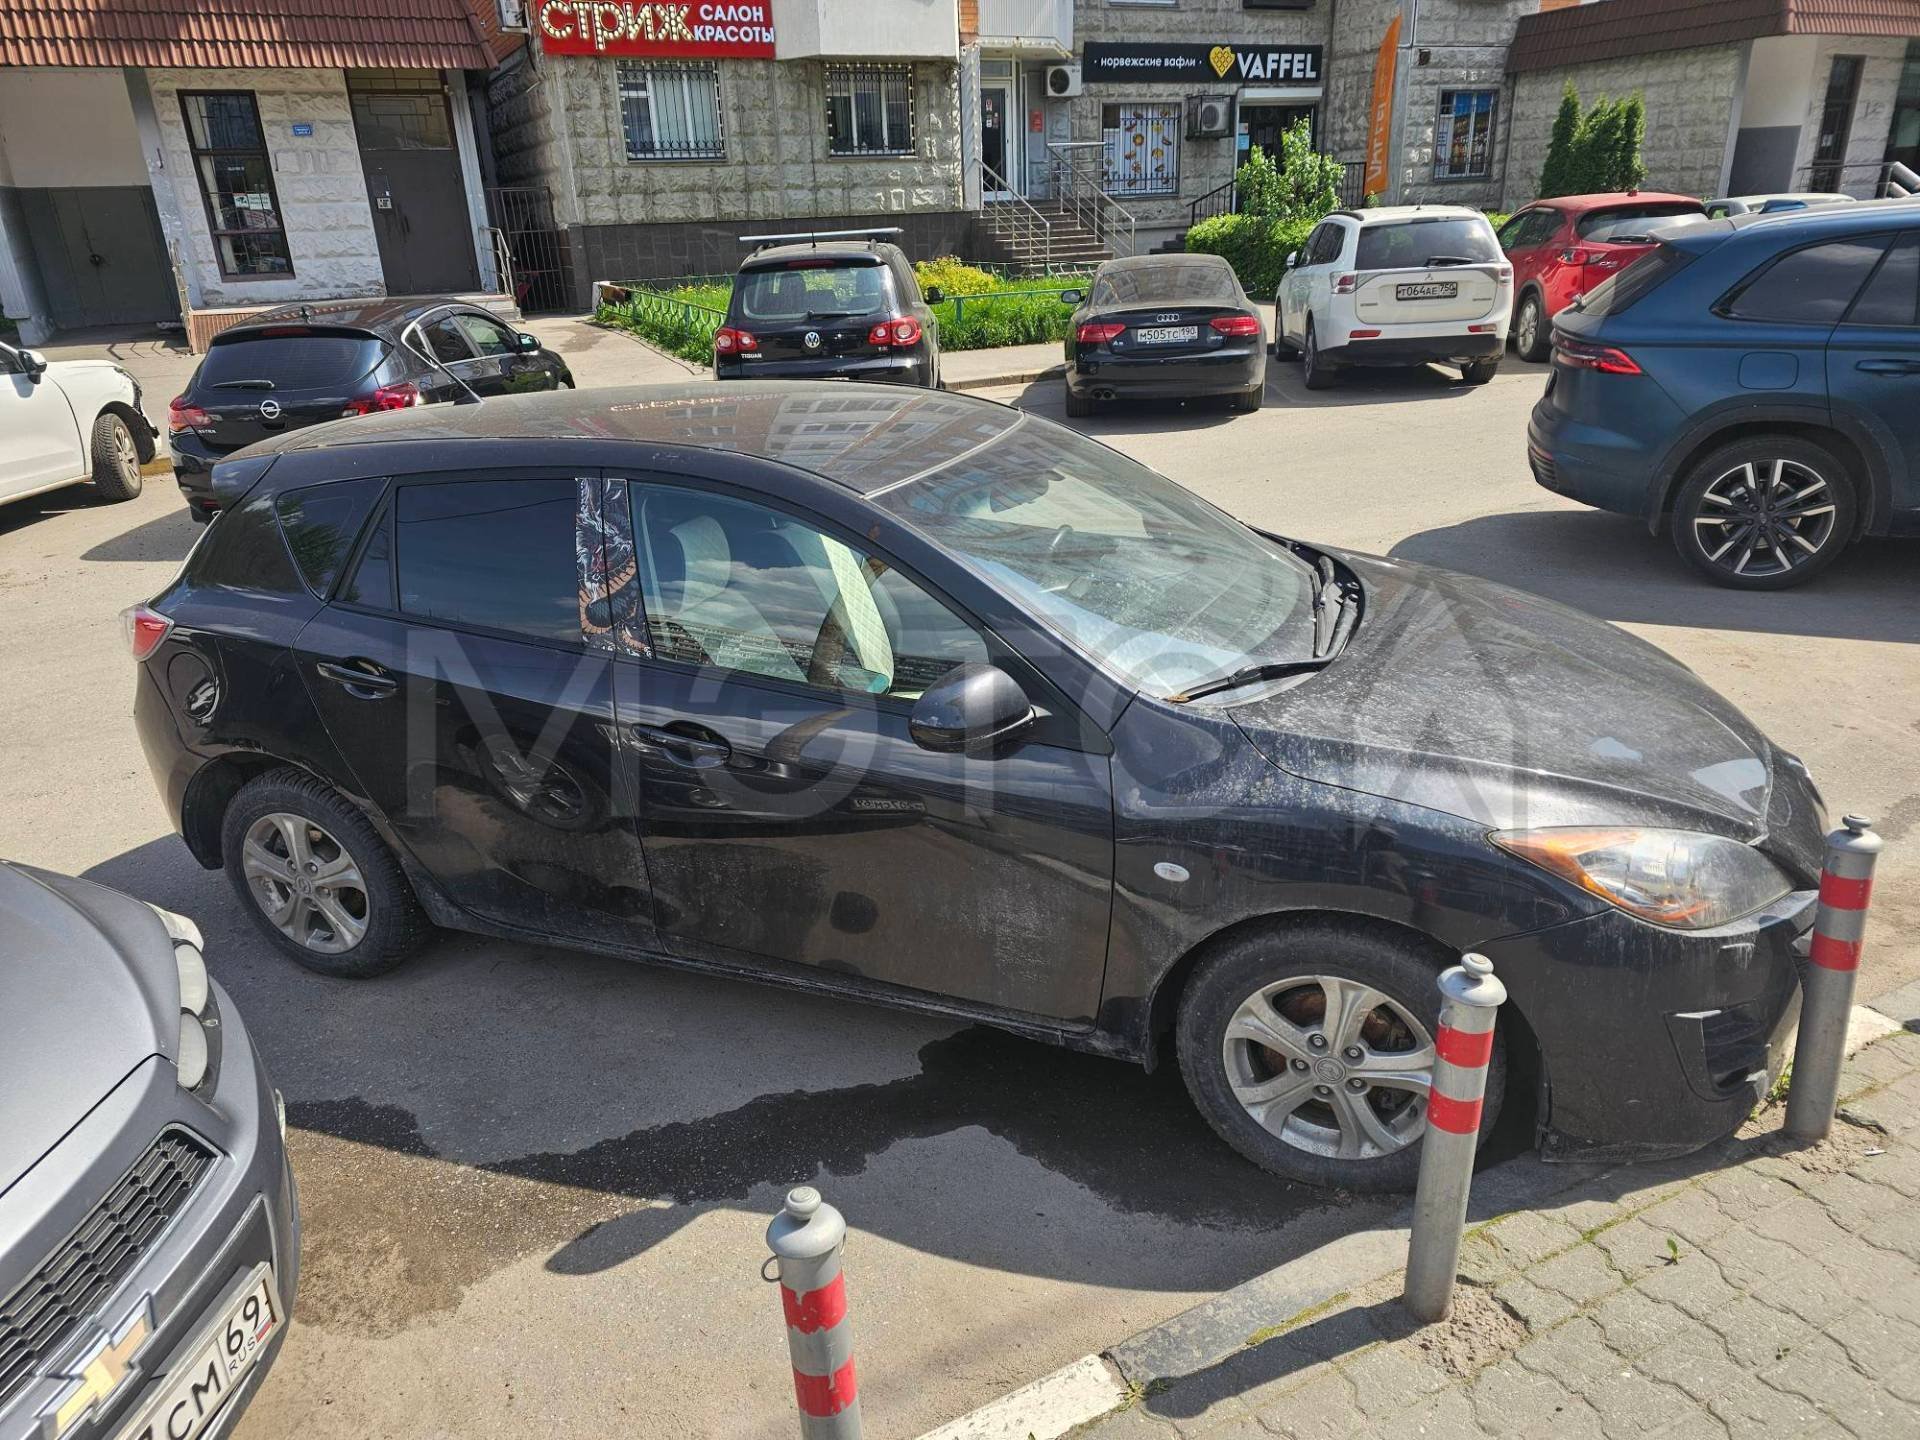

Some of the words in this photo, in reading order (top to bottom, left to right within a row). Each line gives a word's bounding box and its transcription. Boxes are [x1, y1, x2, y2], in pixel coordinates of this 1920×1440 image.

[699, 4, 764, 22] САЛОН
[693, 24, 775, 43] КРАСОТЫ
[1100, 56, 1162, 68] норвежские
[1163, 56, 1196, 68] вафли
[1237, 53, 1317, 79] VAFFEL
[229, 1337, 256, 1375] RUS
[138, 1361, 221, 1440] СМ
[226, 1295, 260, 1356] 69
